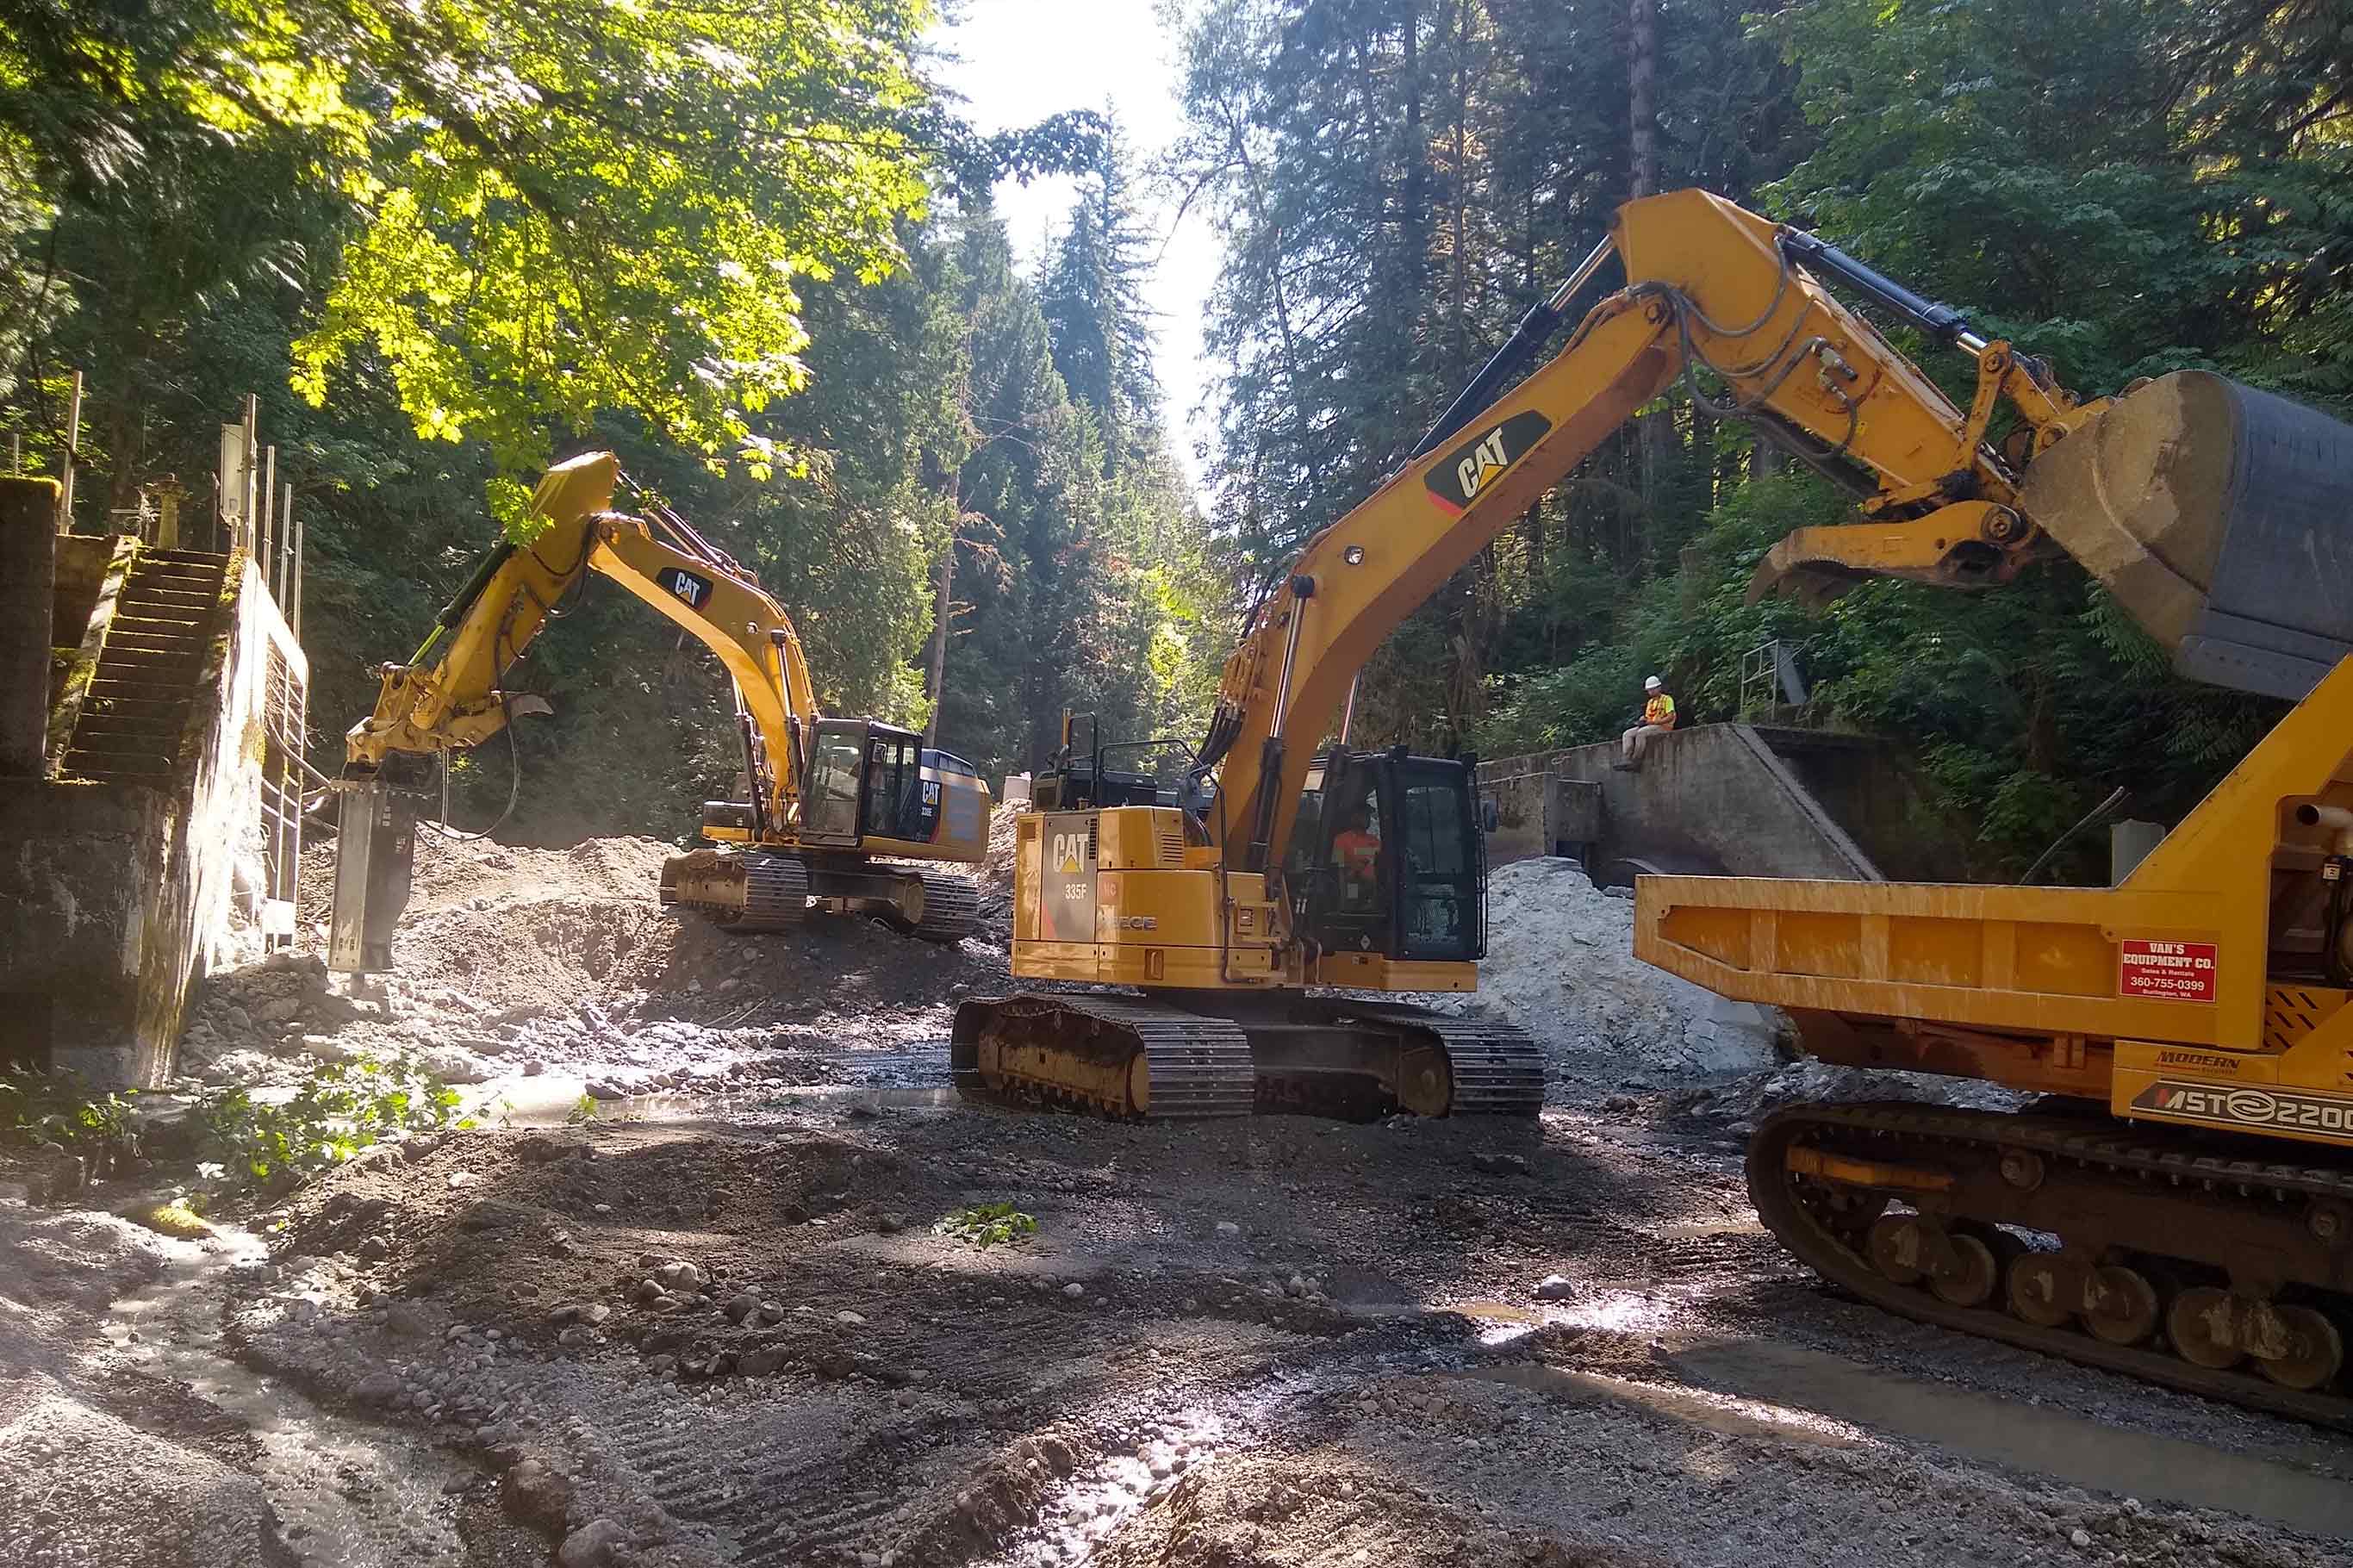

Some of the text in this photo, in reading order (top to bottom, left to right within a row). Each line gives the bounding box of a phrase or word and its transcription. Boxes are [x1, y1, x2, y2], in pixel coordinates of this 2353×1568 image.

[1457, 426, 1509, 498] CAT
[675, 571, 700, 606] CAT
[922, 781, 940, 806] CAT
[1053, 833, 1089, 875] CAT
[1064, 882, 1087, 899] 335F
[2150, 943, 2185, 955] VAN'S
[2123, 954, 2214, 969] EQUIPMENT CO.
[2131, 976, 2205, 991] 360-755-0399
[2157, 1050, 2241, 1069] MODERN
[2157, 1088, 2226, 1115] MST
